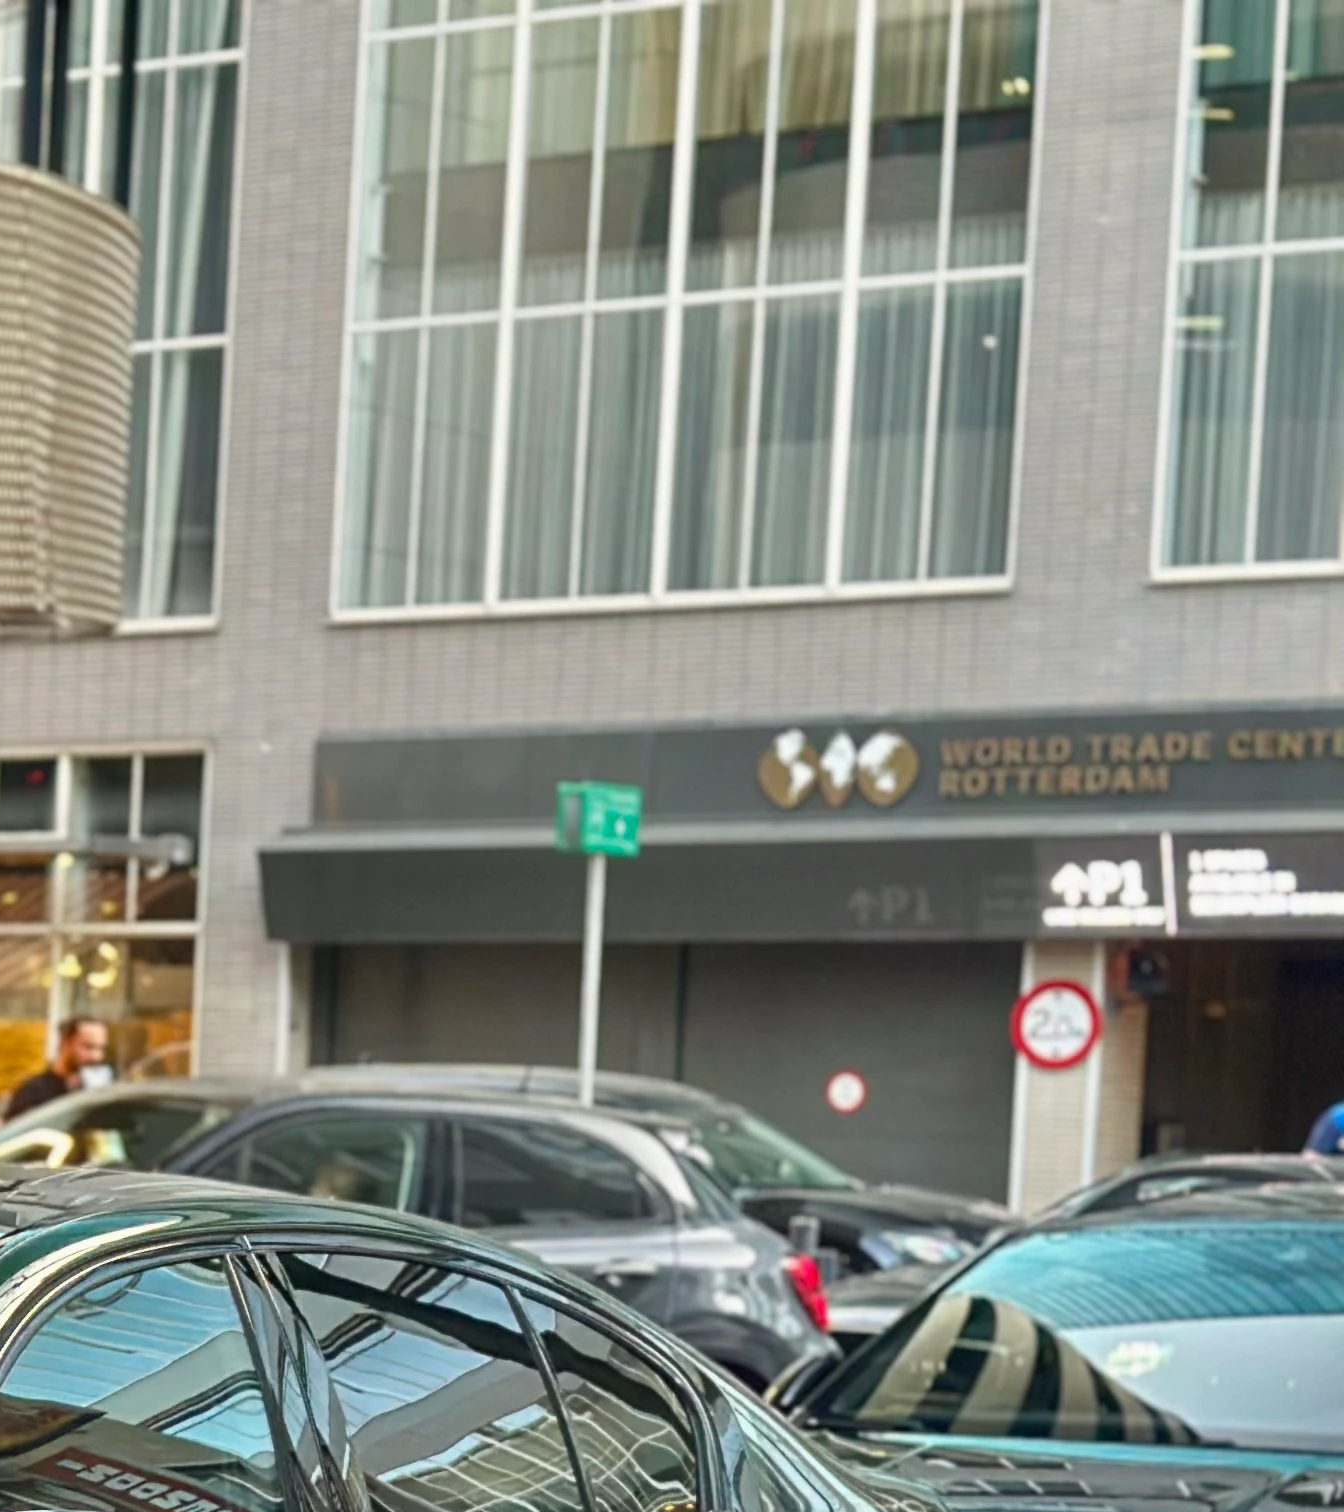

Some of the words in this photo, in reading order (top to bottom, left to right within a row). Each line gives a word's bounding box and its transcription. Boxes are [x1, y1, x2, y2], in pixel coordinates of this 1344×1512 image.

[940, 735, 1072, 767] WORLD
[1088, 731, 1211, 762] TRADE
[938, 764, 1171, 798] ROTTERDAM
[1087, 860, 1149, 906] P1
